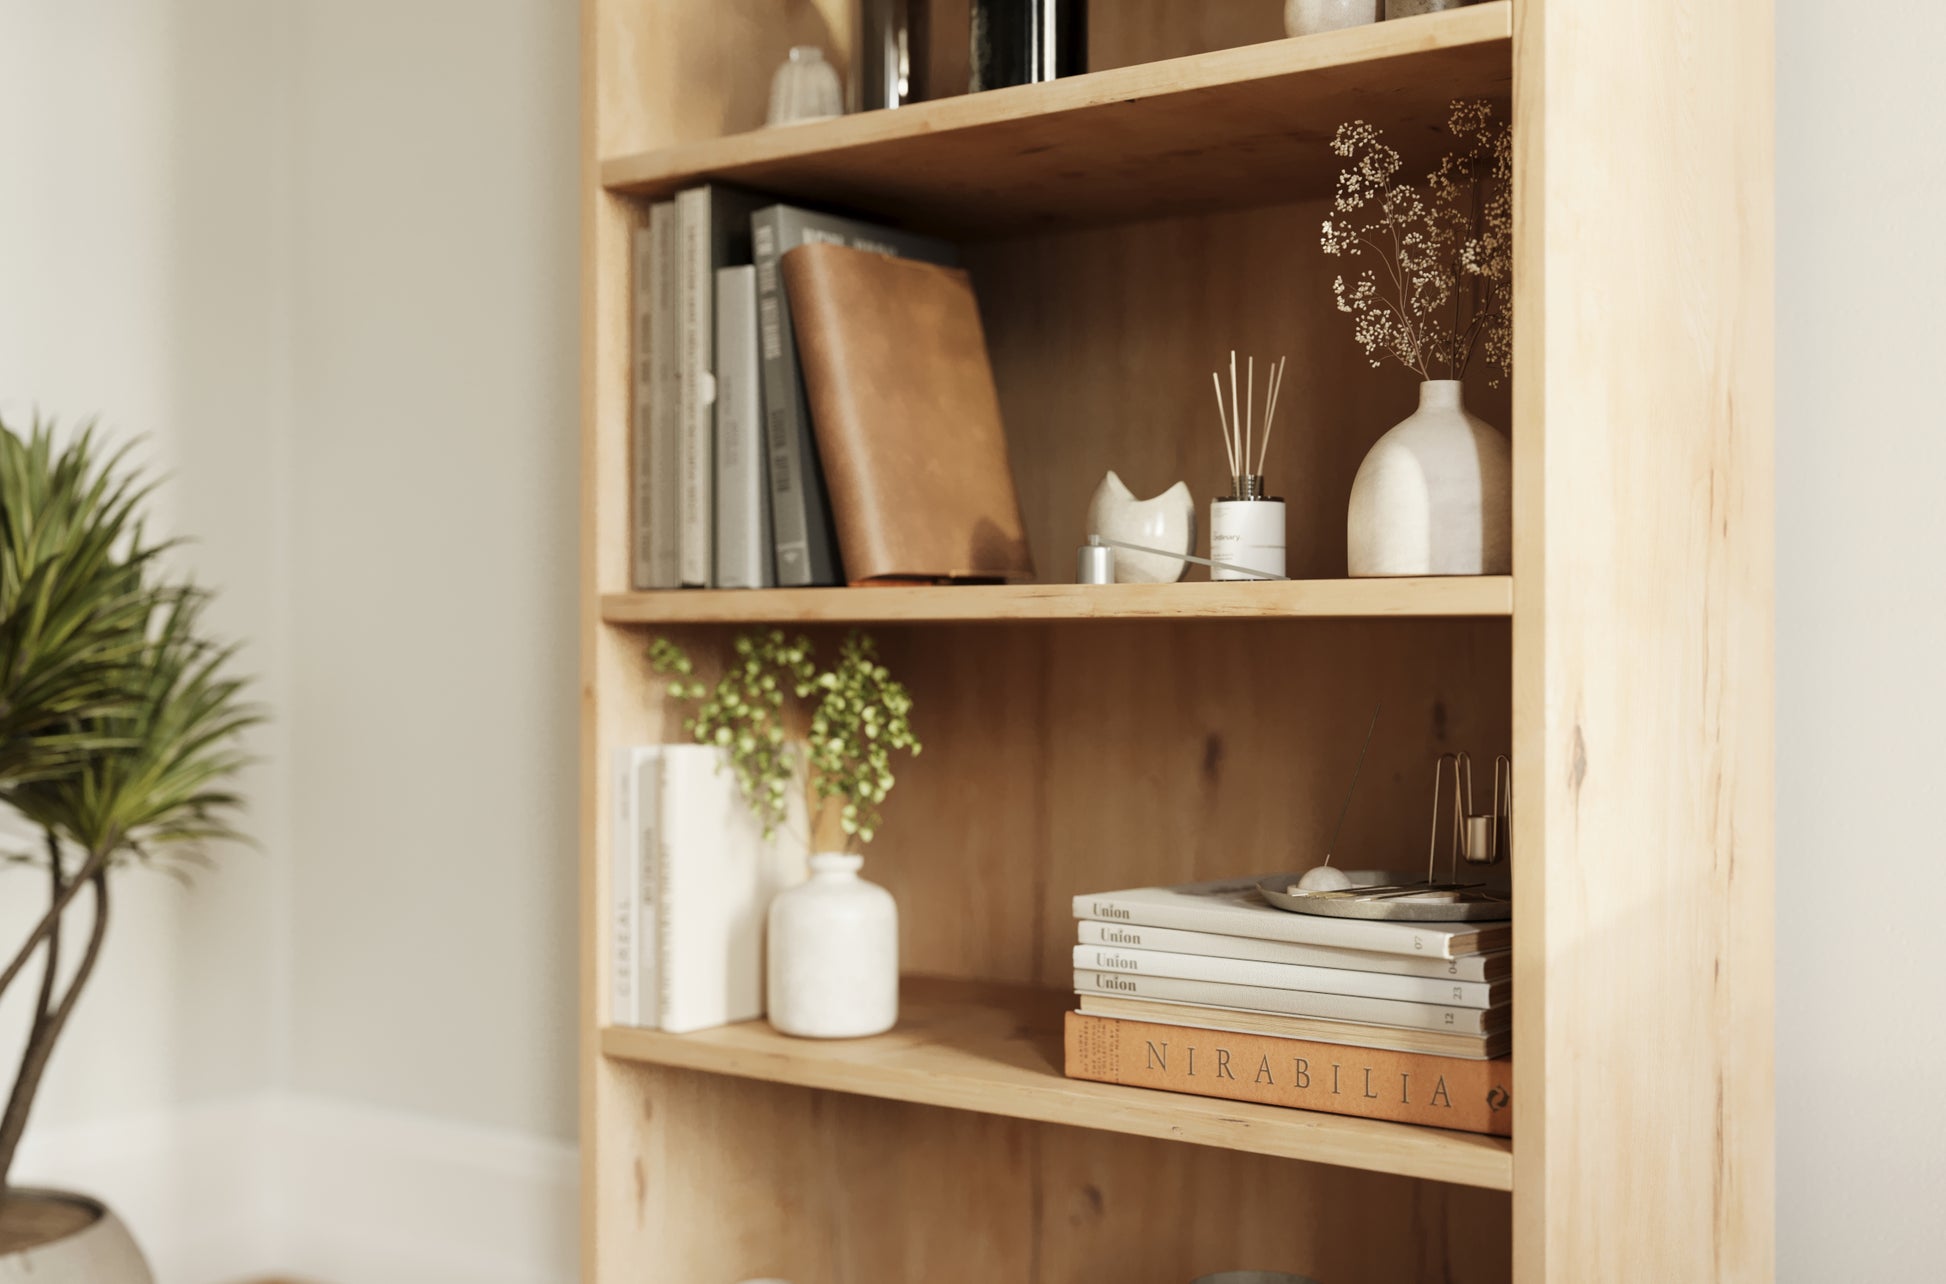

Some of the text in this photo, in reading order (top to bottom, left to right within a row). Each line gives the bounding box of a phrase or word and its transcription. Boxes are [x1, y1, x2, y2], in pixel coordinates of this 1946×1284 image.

[1093, 903, 1130, 919] Union
[1101, 927, 1141, 945] Union
[1414, 935, 1423, 950] 07
[1096, 952, 1138, 970] Union
[1096, 974, 1136, 991] Union
[1445, 1012, 1454, 1025] 12
[1146, 1040, 1451, 1108] NIRABILIA
